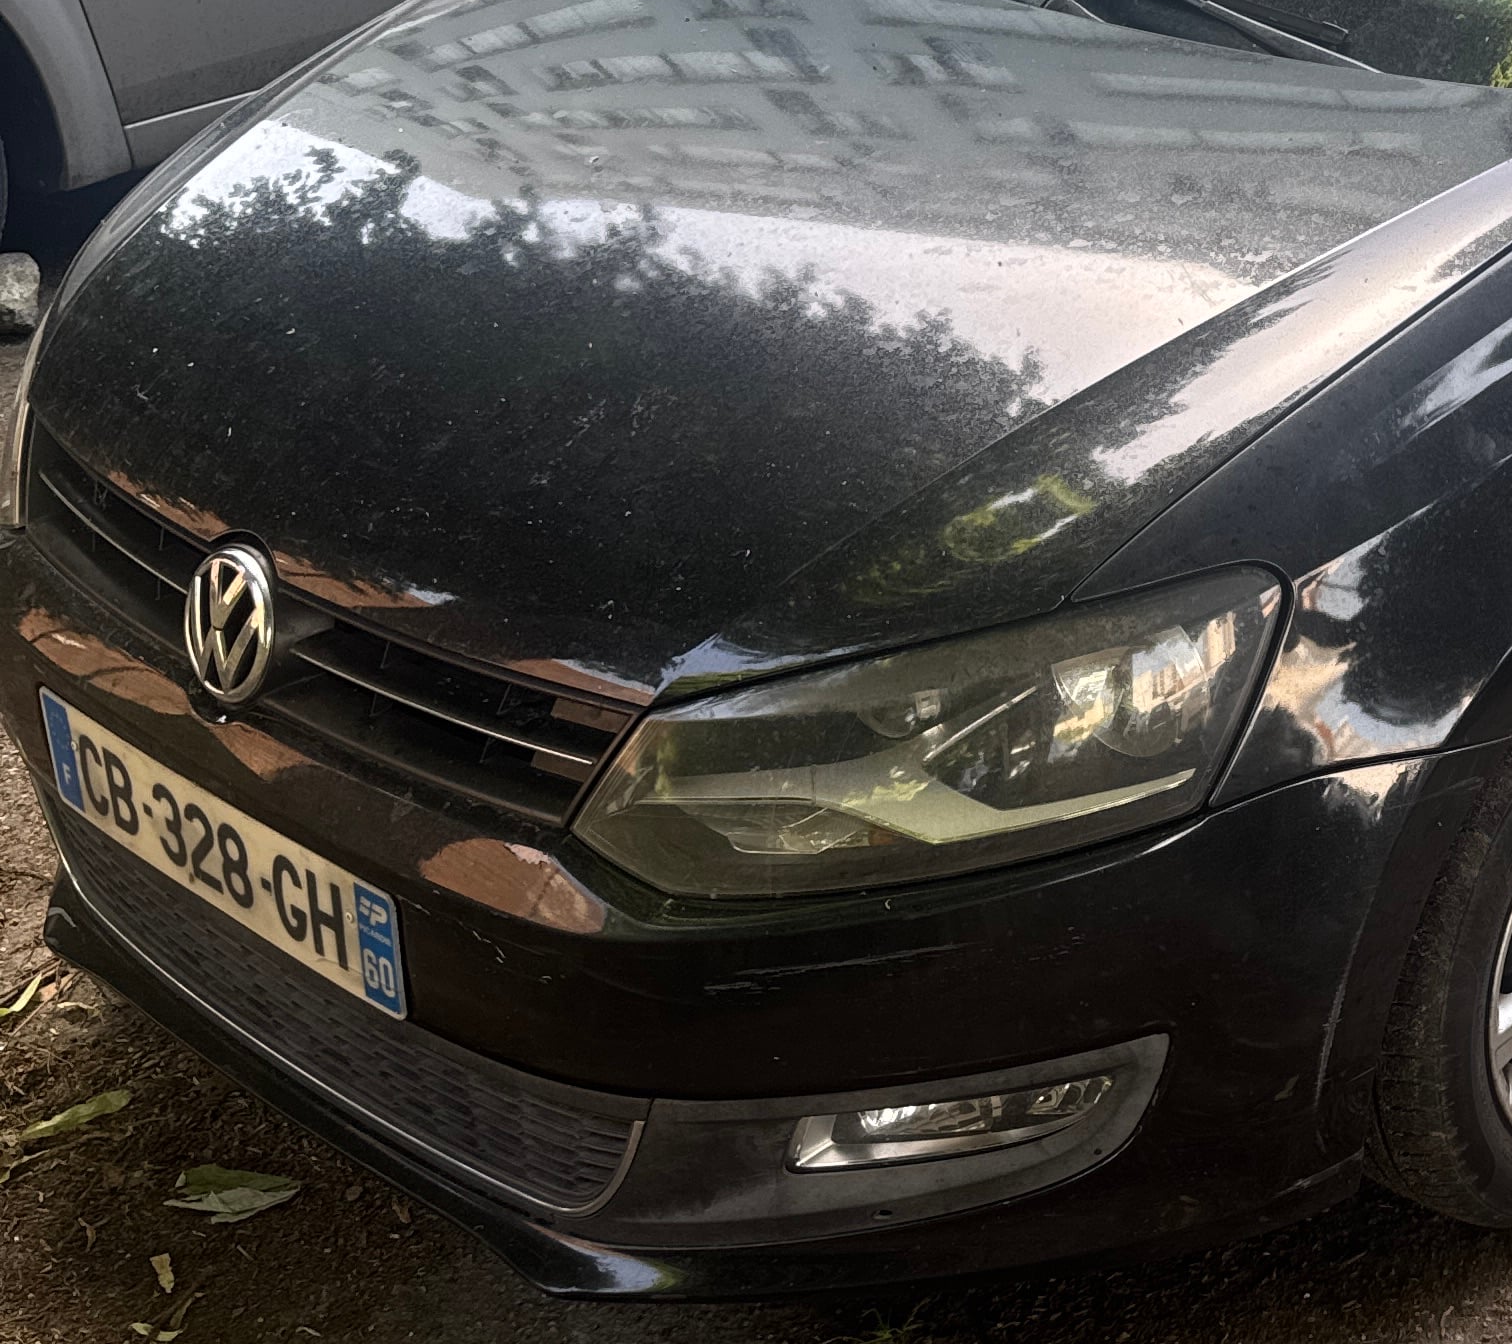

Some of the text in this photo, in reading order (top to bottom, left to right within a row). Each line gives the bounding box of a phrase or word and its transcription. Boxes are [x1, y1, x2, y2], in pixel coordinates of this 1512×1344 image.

[62, 762, 72, 785] F
[79, 734, 349, 971] CB-328-GH
[363, 948, 396, 998] 60
